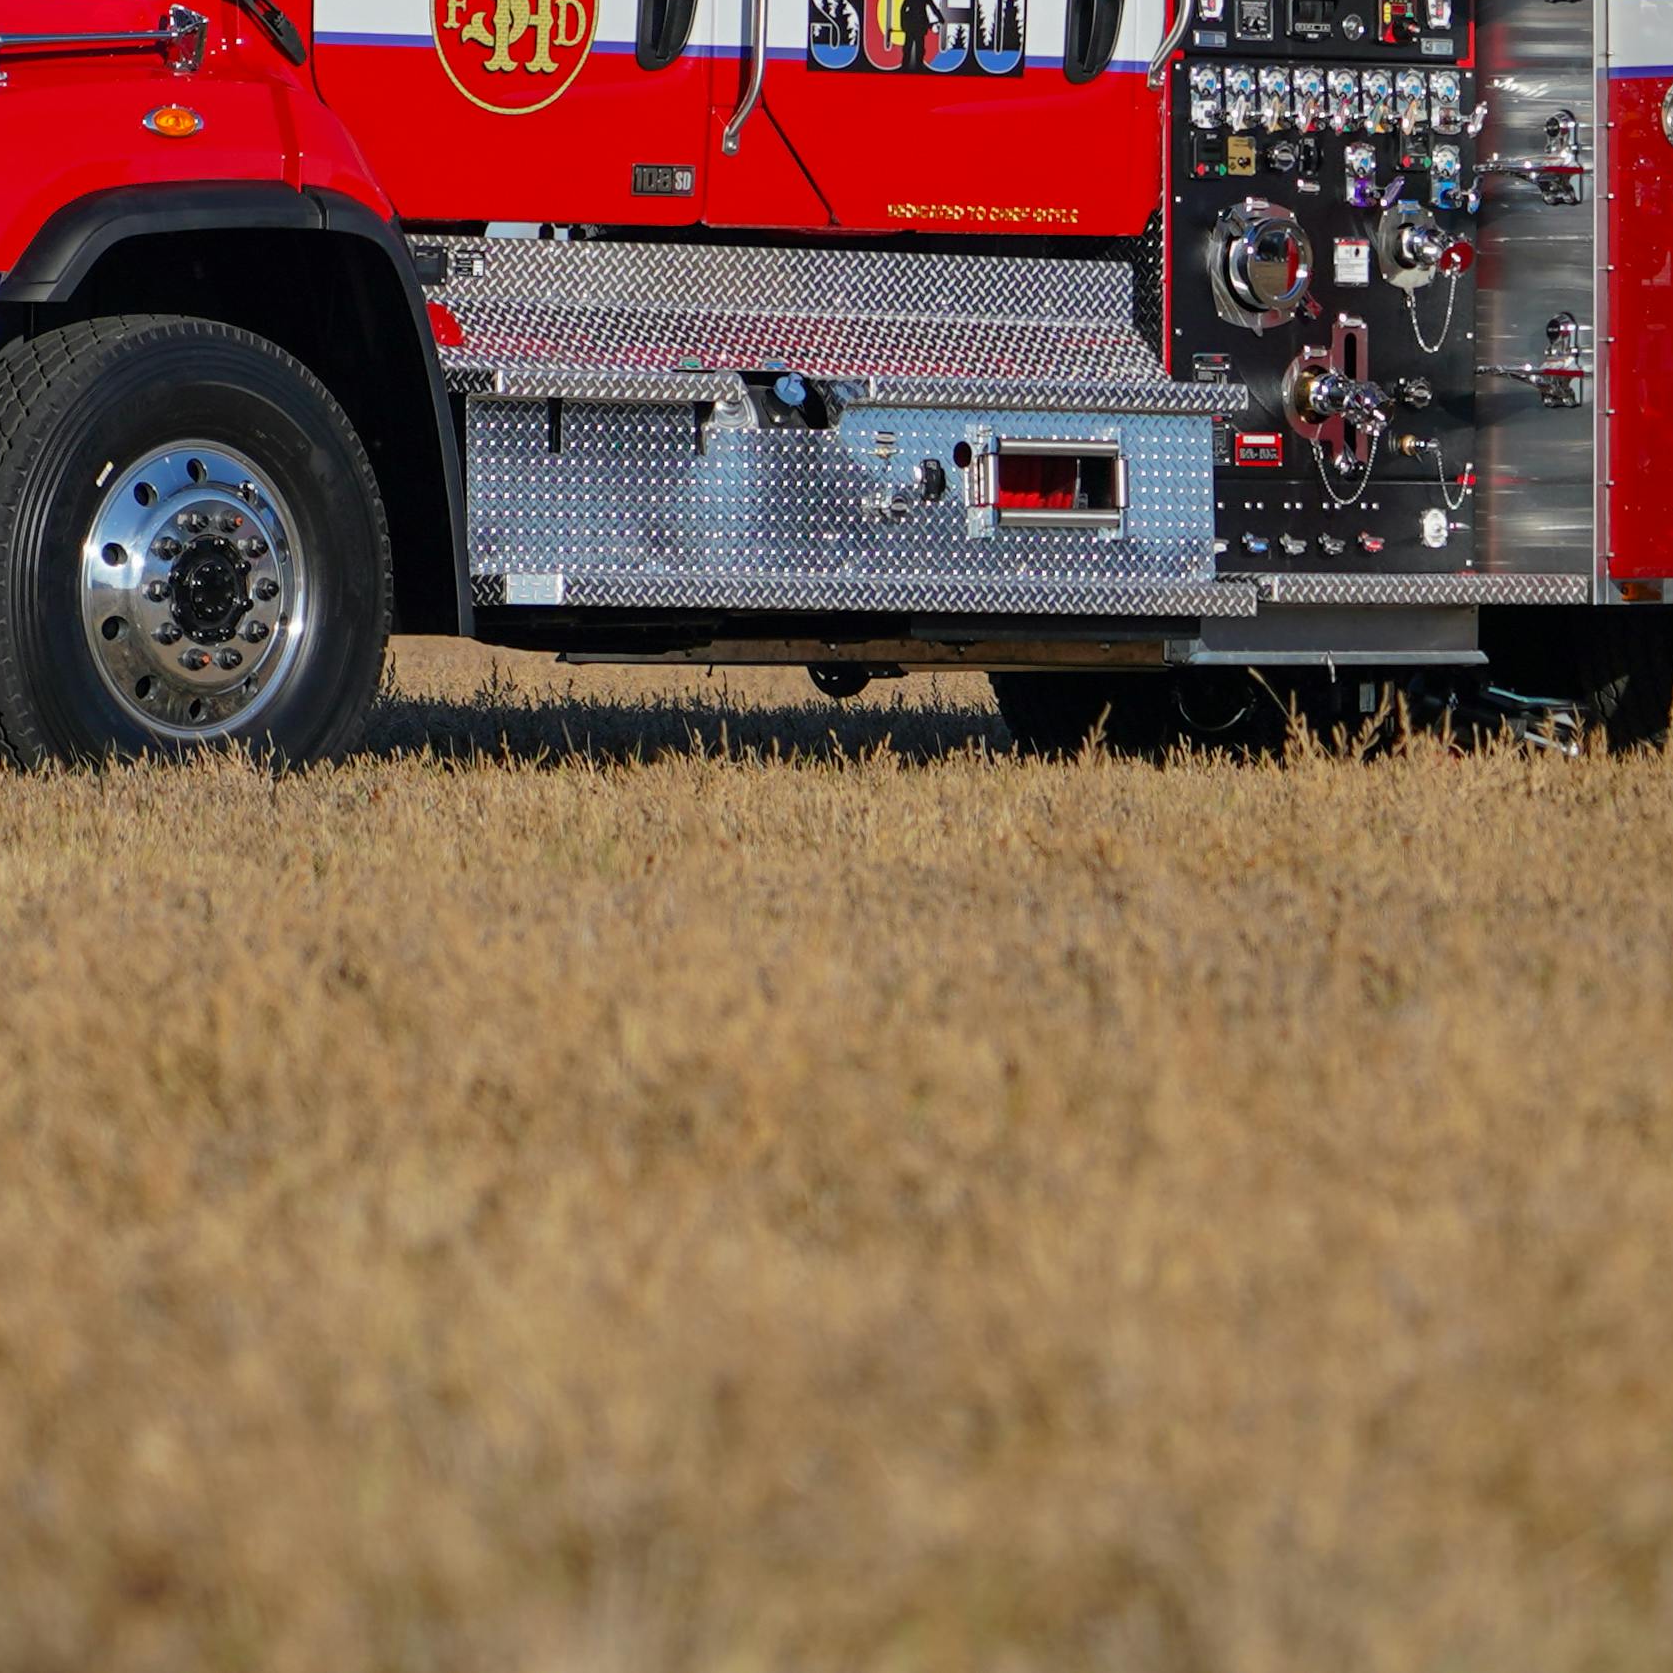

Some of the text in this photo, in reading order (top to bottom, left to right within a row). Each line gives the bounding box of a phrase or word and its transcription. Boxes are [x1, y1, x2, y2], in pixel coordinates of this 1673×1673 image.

[635, 166, 692, 192] 108 SD
[967, 205, 987, 221] TO
